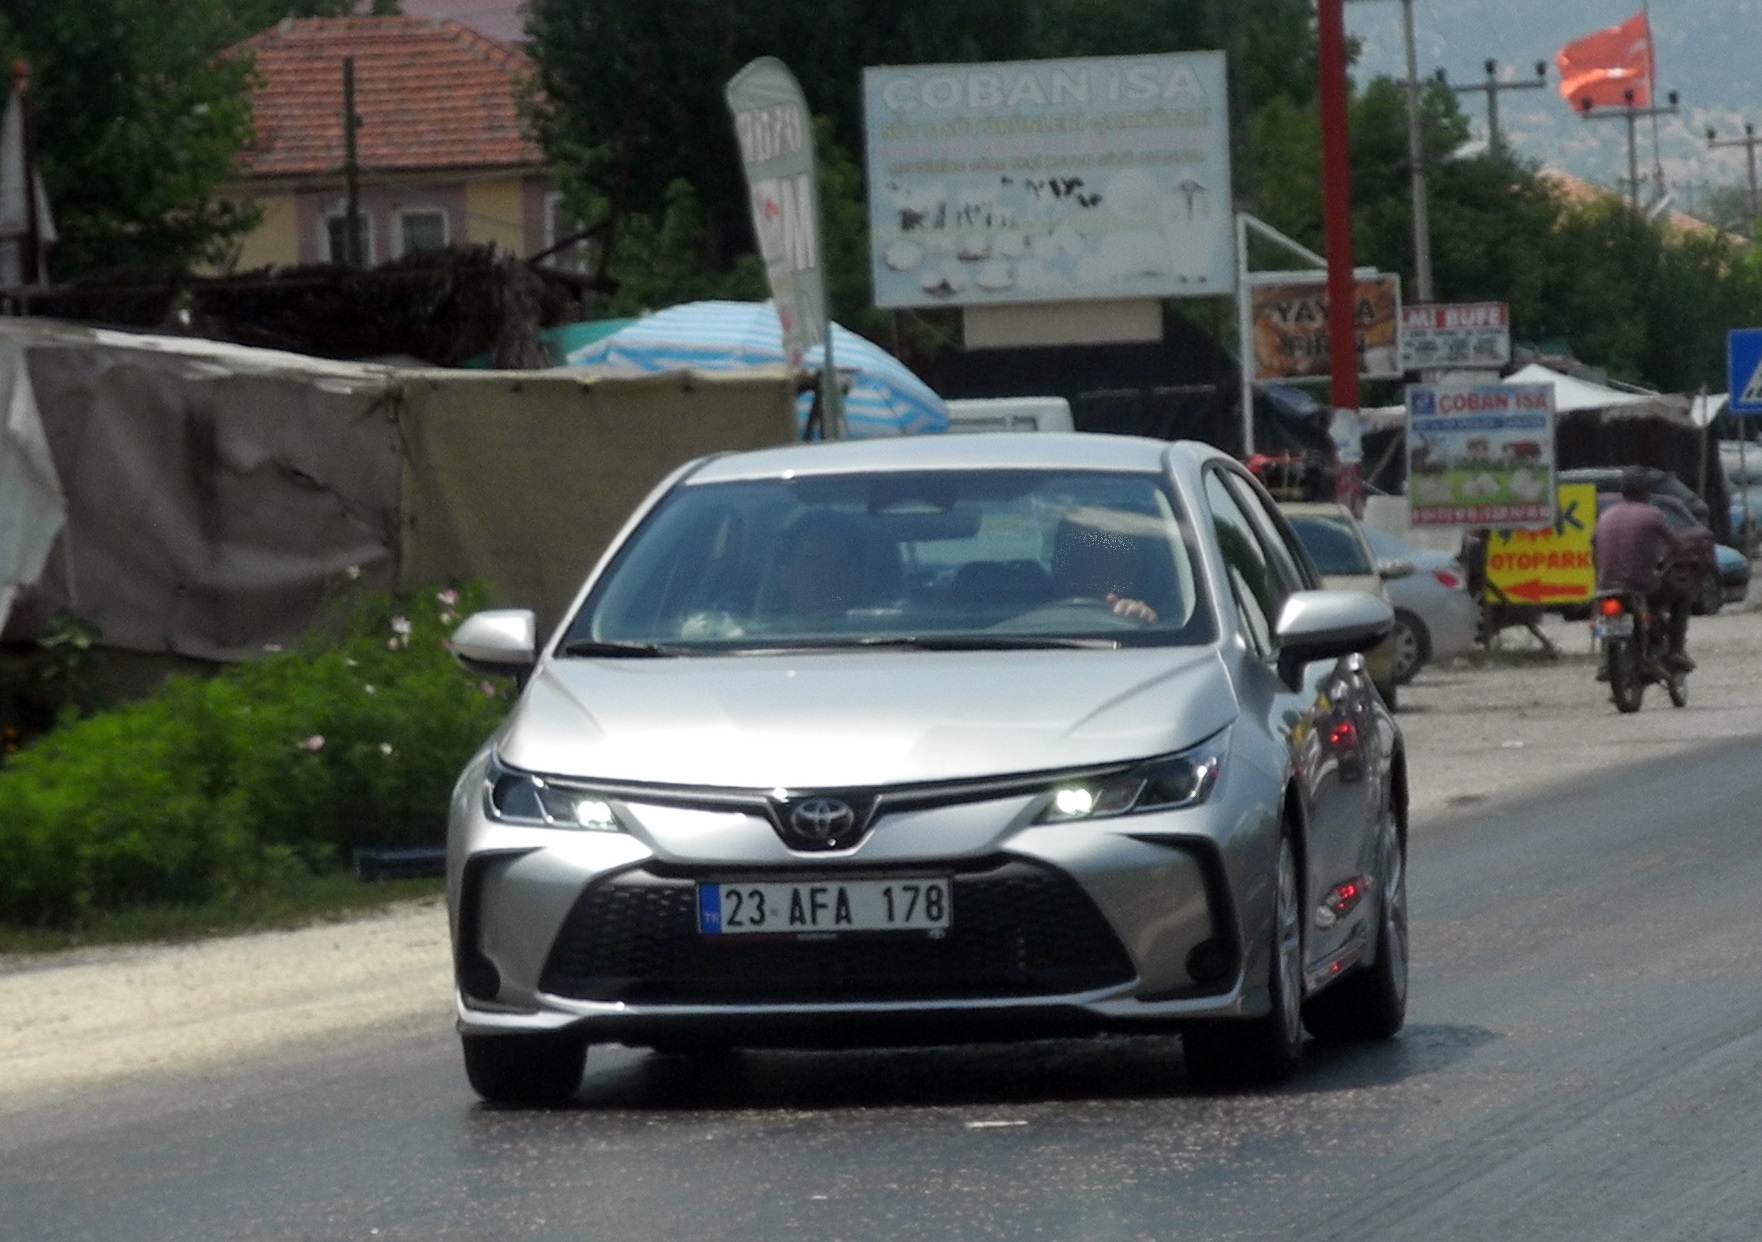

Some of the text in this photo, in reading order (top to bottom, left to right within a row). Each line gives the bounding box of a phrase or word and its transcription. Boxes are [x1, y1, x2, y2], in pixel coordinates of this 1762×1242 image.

[1275, 297, 1376, 322] YAYA
[1490, 551, 1591, 571] OTOPARK
[725, 889, 767, 927] 23
[789, 886, 853, 926] AFA
[882, 883, 945, 923] 178
